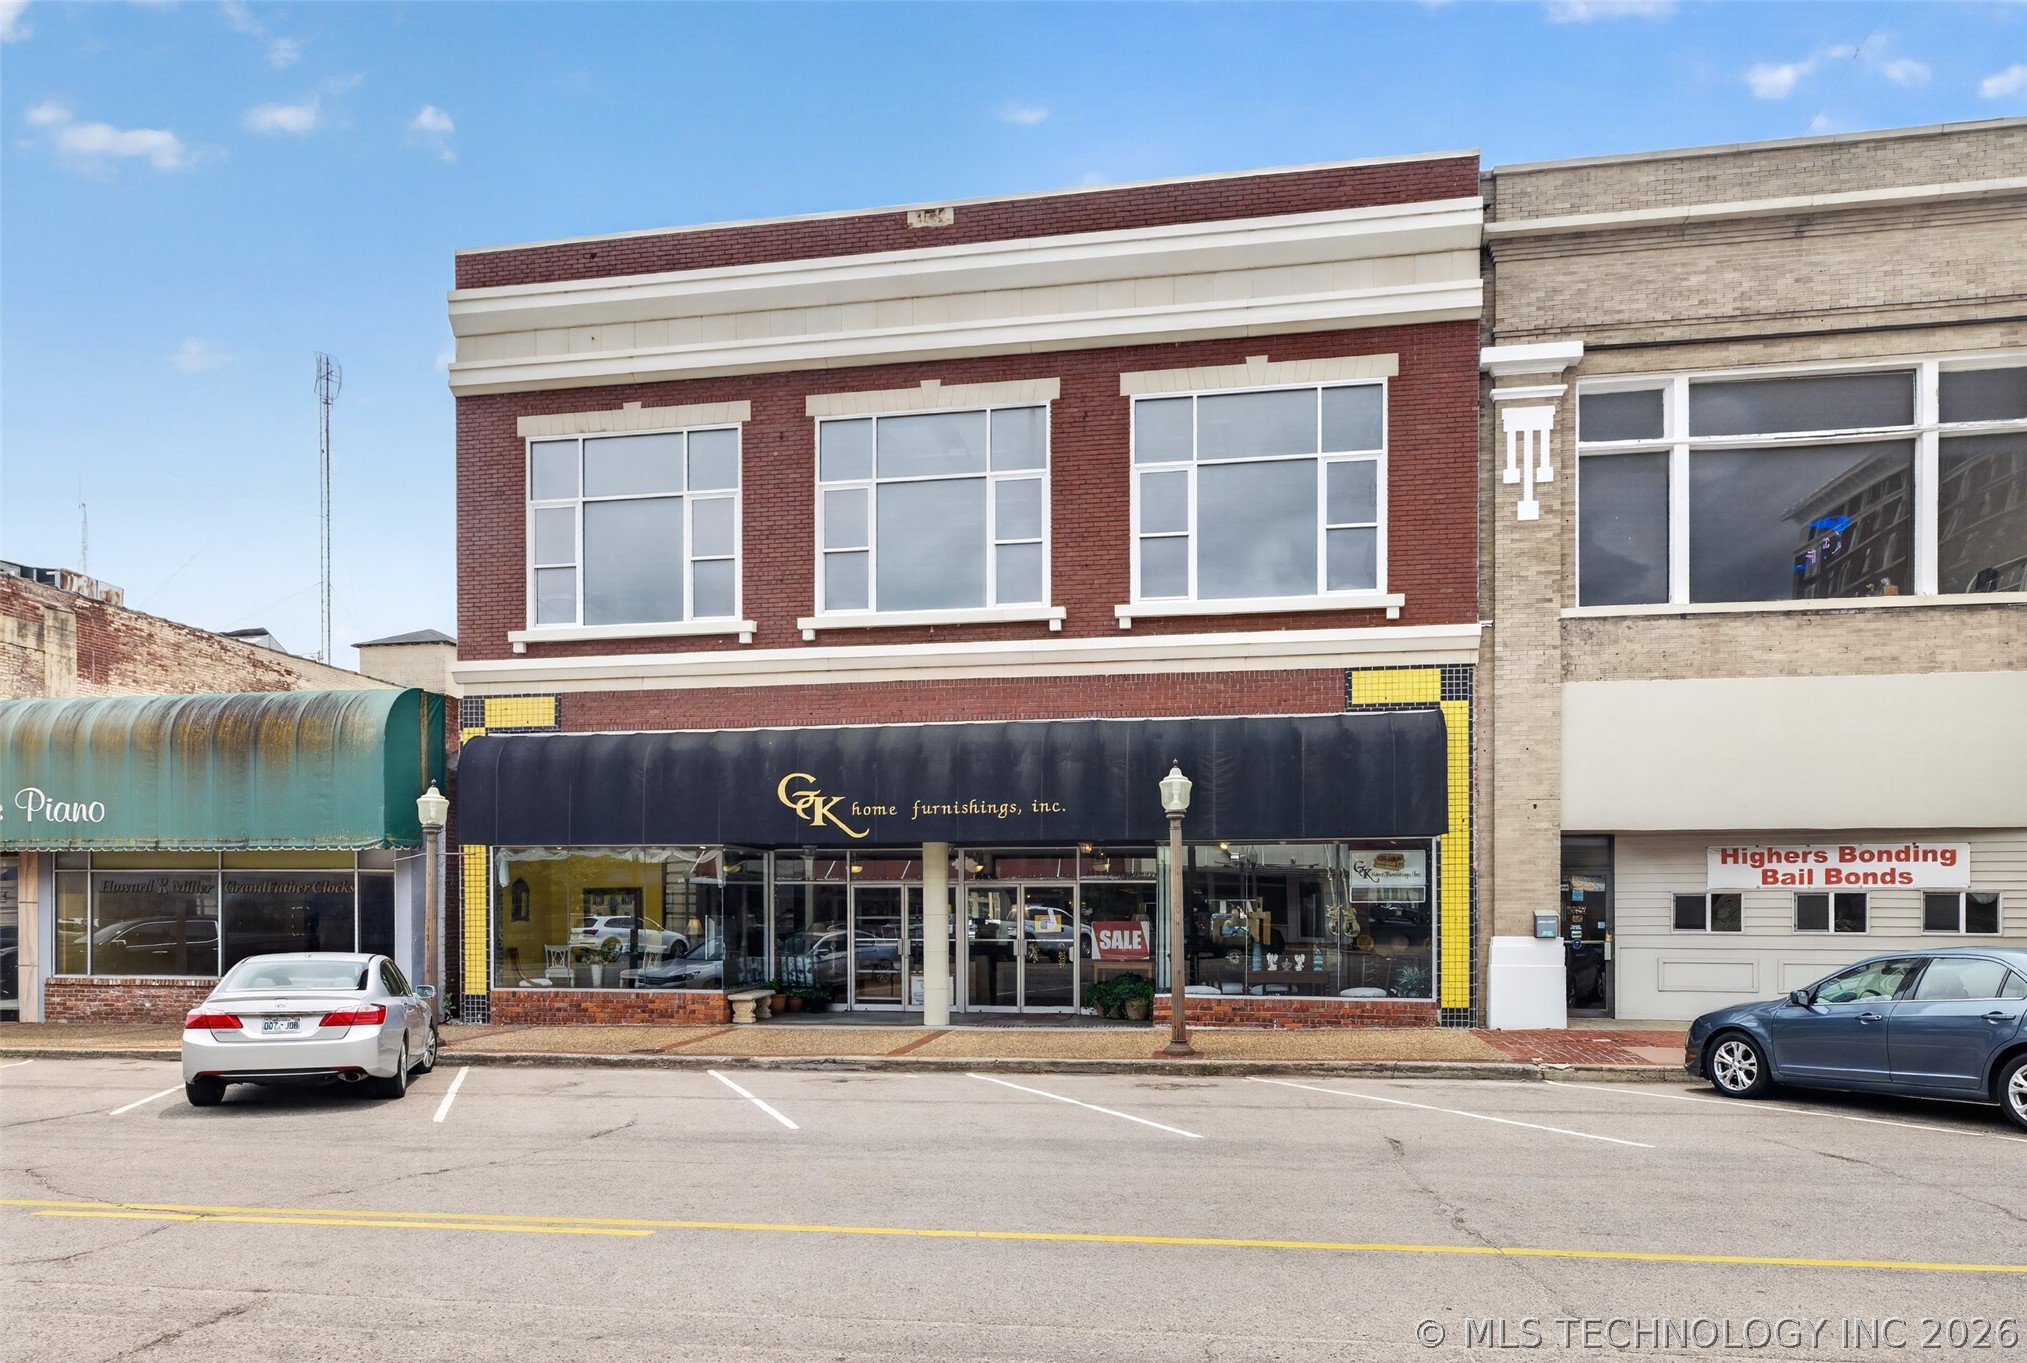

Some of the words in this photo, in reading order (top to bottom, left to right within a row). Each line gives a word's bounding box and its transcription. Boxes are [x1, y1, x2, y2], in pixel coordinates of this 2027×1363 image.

[15, 787, 105, 823] Piano
[851, 801, 897, 816] home
[911, 799, 1022, 820] furnishings,
[1031, 799, 1066, 813] inc.
[1720, 847, 1828, 869] Highers
[1838, 845, 1957, 867] Bonding
[172, 880, 215, 894] Miller
[312, 880, 355, 894] Clocks
[1761, 868, 1814, 886] Bail
[1824, 868, 1914, 886] Bonds
[1099, 929, 1142, 950] SALE
